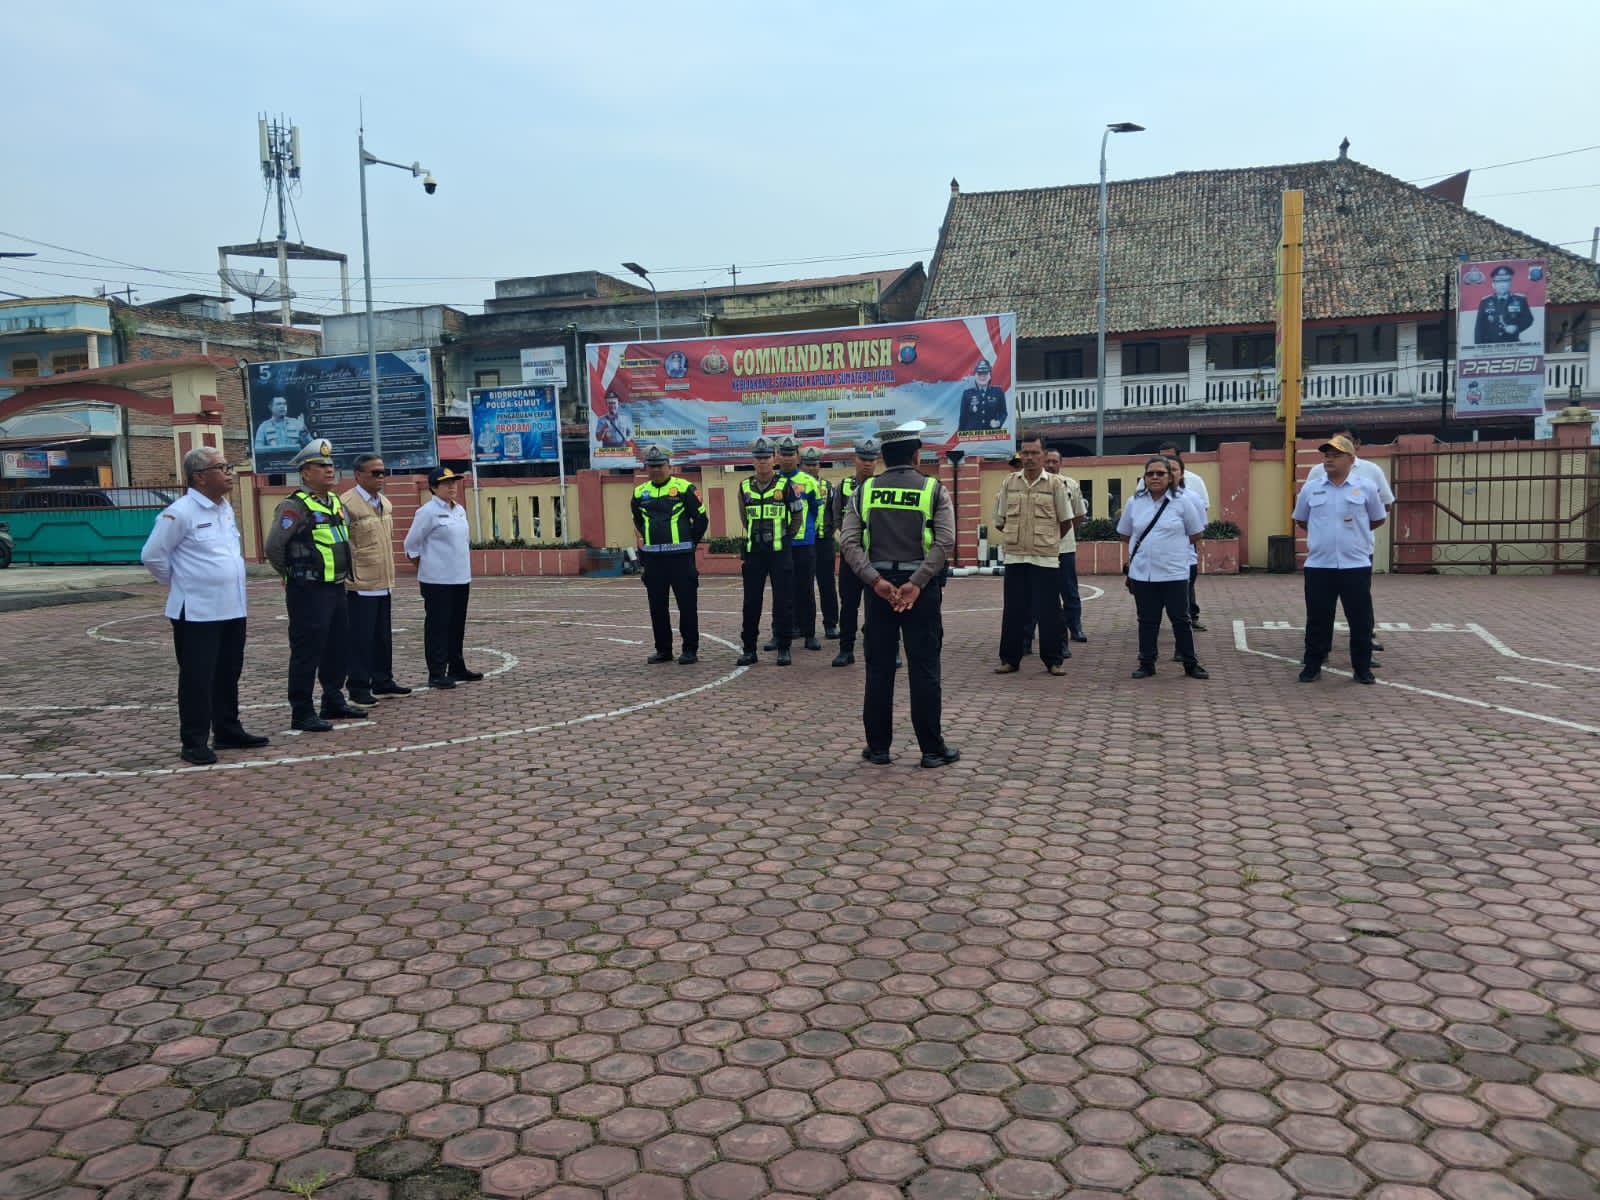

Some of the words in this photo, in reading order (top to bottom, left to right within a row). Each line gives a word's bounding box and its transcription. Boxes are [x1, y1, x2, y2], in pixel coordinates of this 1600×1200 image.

[732, 343, 845, 376] COMMANDER
[847, 338, 893, 368] WISH
[259, 365, 271, 380] 5
[1463, 358, 1538, 375] PRESISI
[489, 389, 536, 399] BIDPROPAM
[486, 401, 512, 409] POLDA
[514, 399, 541, 408] SUMUT
[496, 423, 530, 432] PROPAM
[870, 490, 921, 507] POLISI
